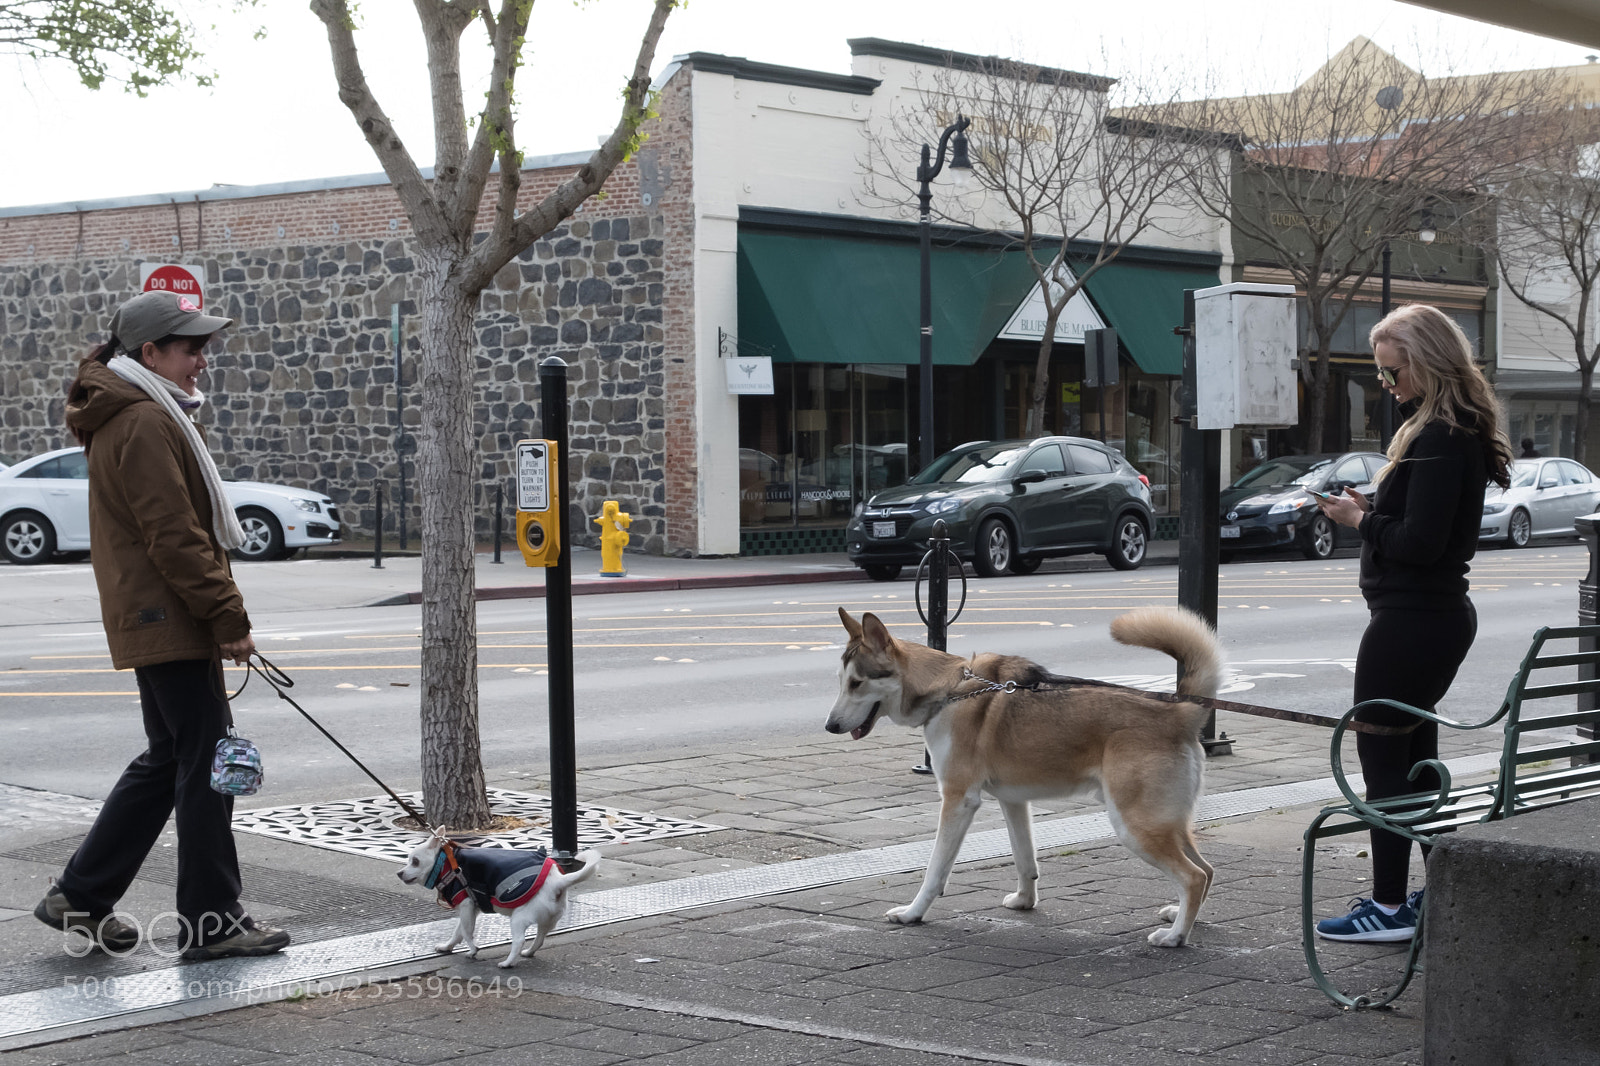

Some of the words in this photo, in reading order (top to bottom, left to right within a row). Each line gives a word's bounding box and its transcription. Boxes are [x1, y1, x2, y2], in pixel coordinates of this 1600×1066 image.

[151, 278, 167, 289] DO
[172, 279, 194, 291] NOT
[1021, 319, 1069, 333] BLUESNE
[525, 460, 539, 468] PUSH
[520, 468, 537, 476] BUTTON
[538, 468, 544, 476] TO
[521, 476, 533, 484] TURN
[536, 476, 544, 484] ON
[522, 484, 543, 492] WARNING
[524, 495, 541, 503] LIGHTS
